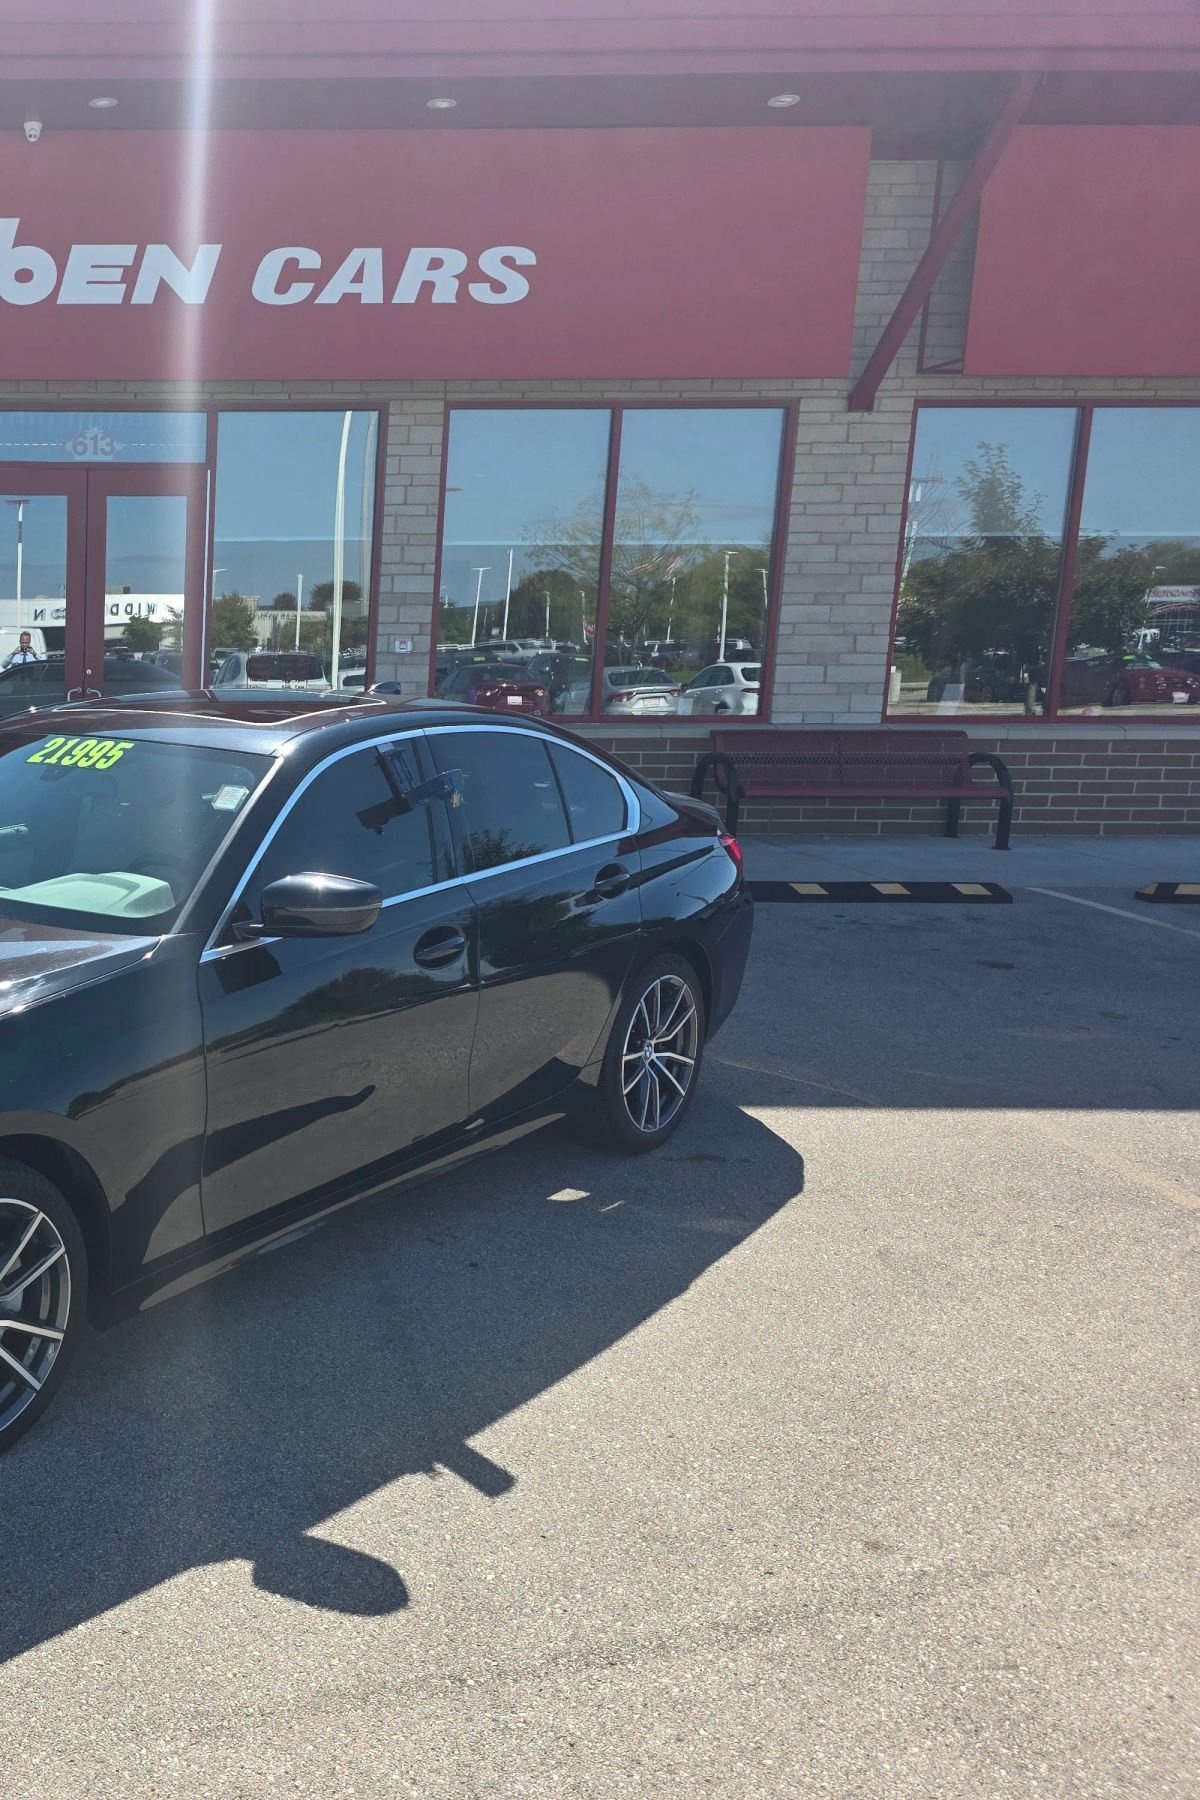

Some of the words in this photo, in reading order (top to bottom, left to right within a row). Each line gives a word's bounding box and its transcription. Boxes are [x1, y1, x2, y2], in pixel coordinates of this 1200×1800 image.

[252, 246, 537, 305] CARS
[72, 432, 115, 456] 613
[27, 737, 135, 769] 21995
